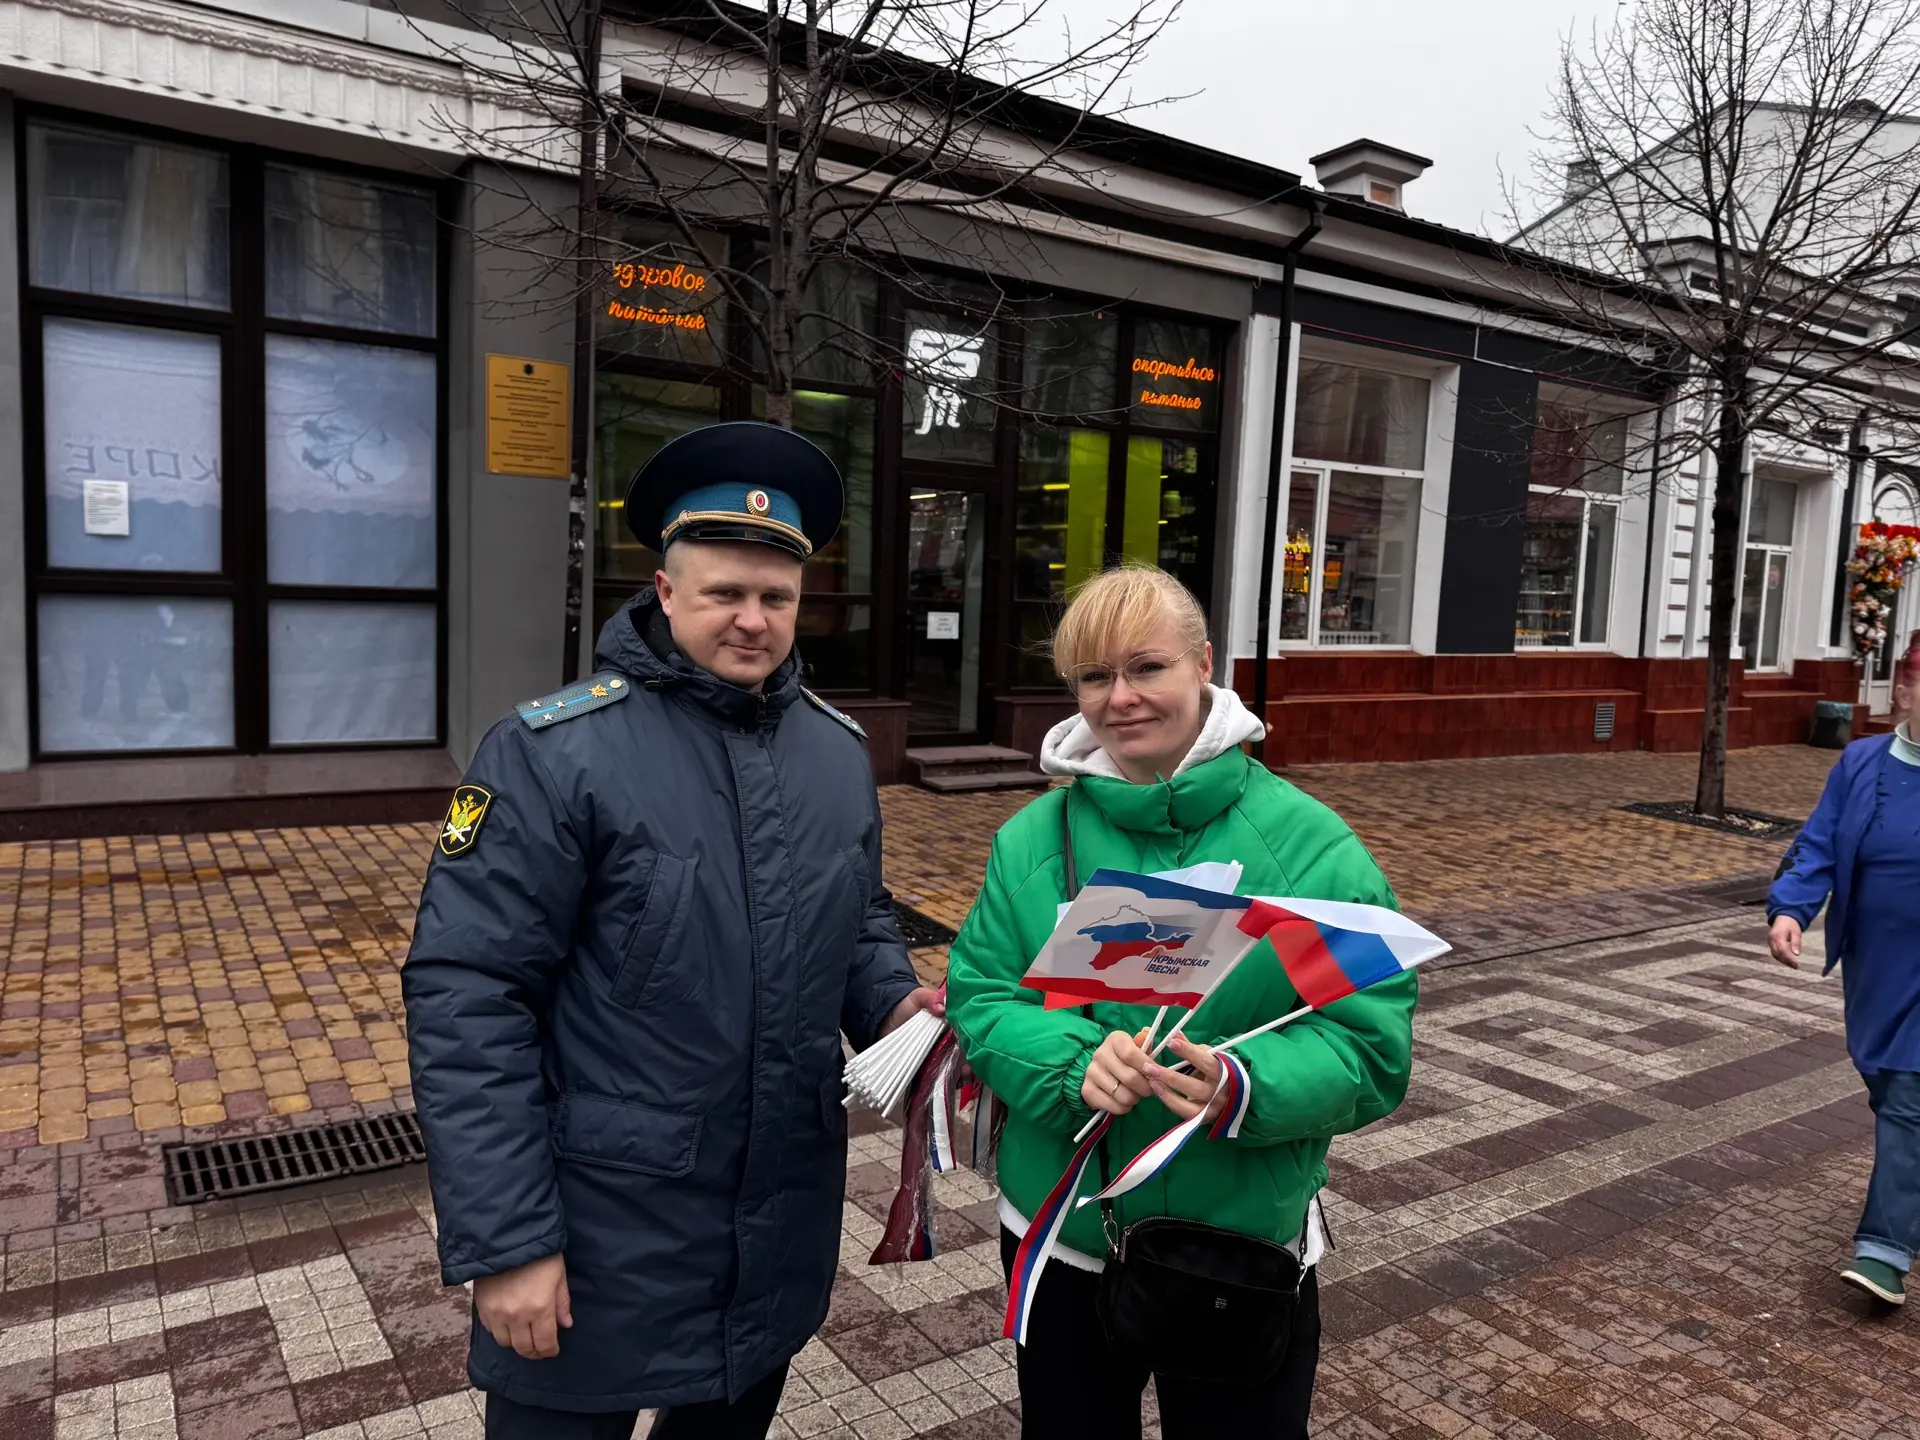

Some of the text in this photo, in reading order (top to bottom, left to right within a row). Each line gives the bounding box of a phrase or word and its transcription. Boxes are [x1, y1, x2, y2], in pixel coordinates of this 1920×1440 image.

[1132, 358, 1215, 381] спортивное
[1141, 390, 1202, 410] питание
[1147, 963, 1180, 975] ВЕСНА
[1153, 954, 1211, 968] КРЫМСКАЯ
